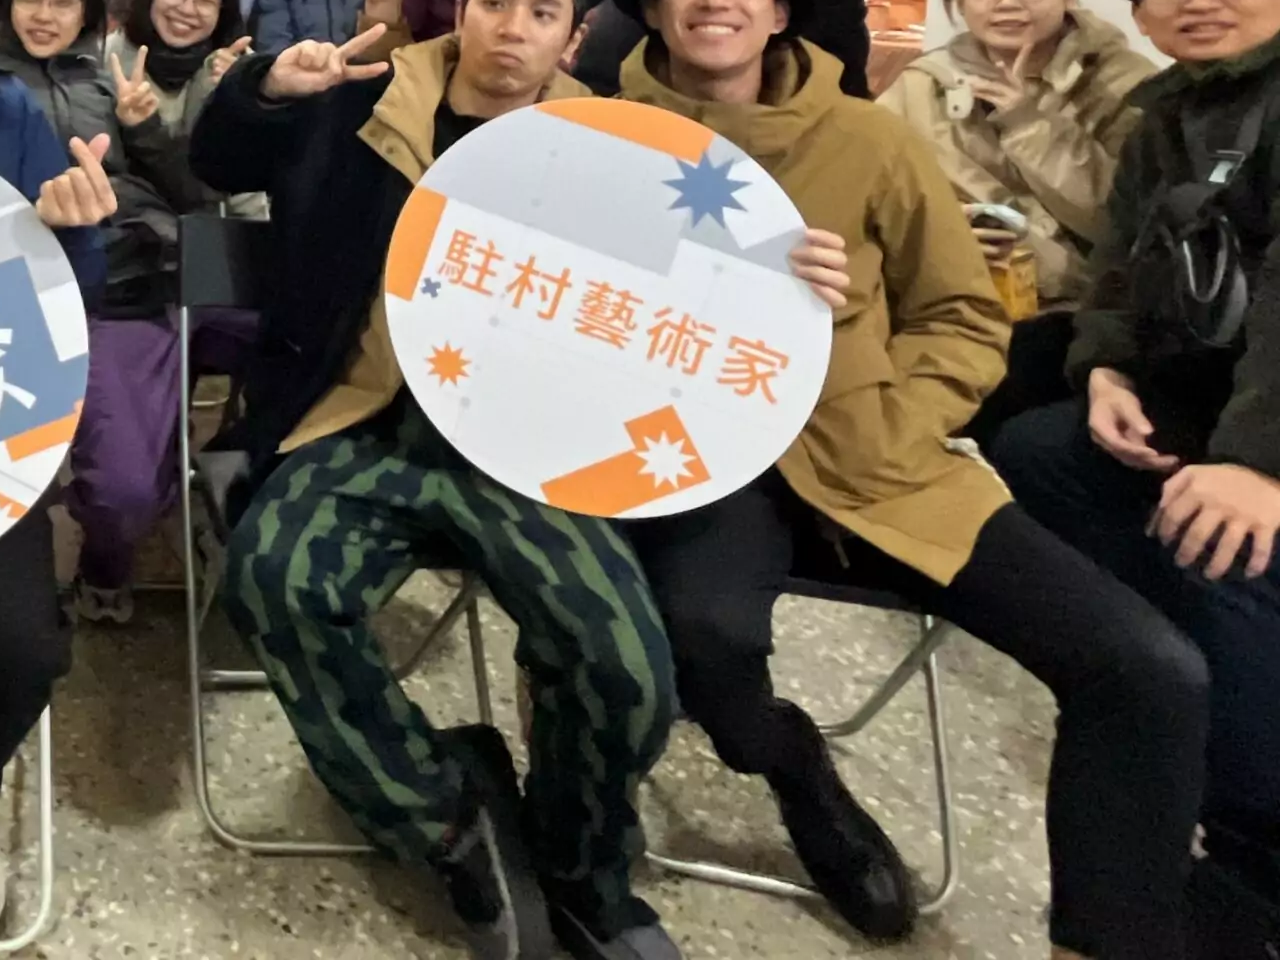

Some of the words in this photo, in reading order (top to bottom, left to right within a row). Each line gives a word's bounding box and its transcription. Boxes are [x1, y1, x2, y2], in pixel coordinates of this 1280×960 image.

[436, 229, 790, 405] 駐村藝術家
